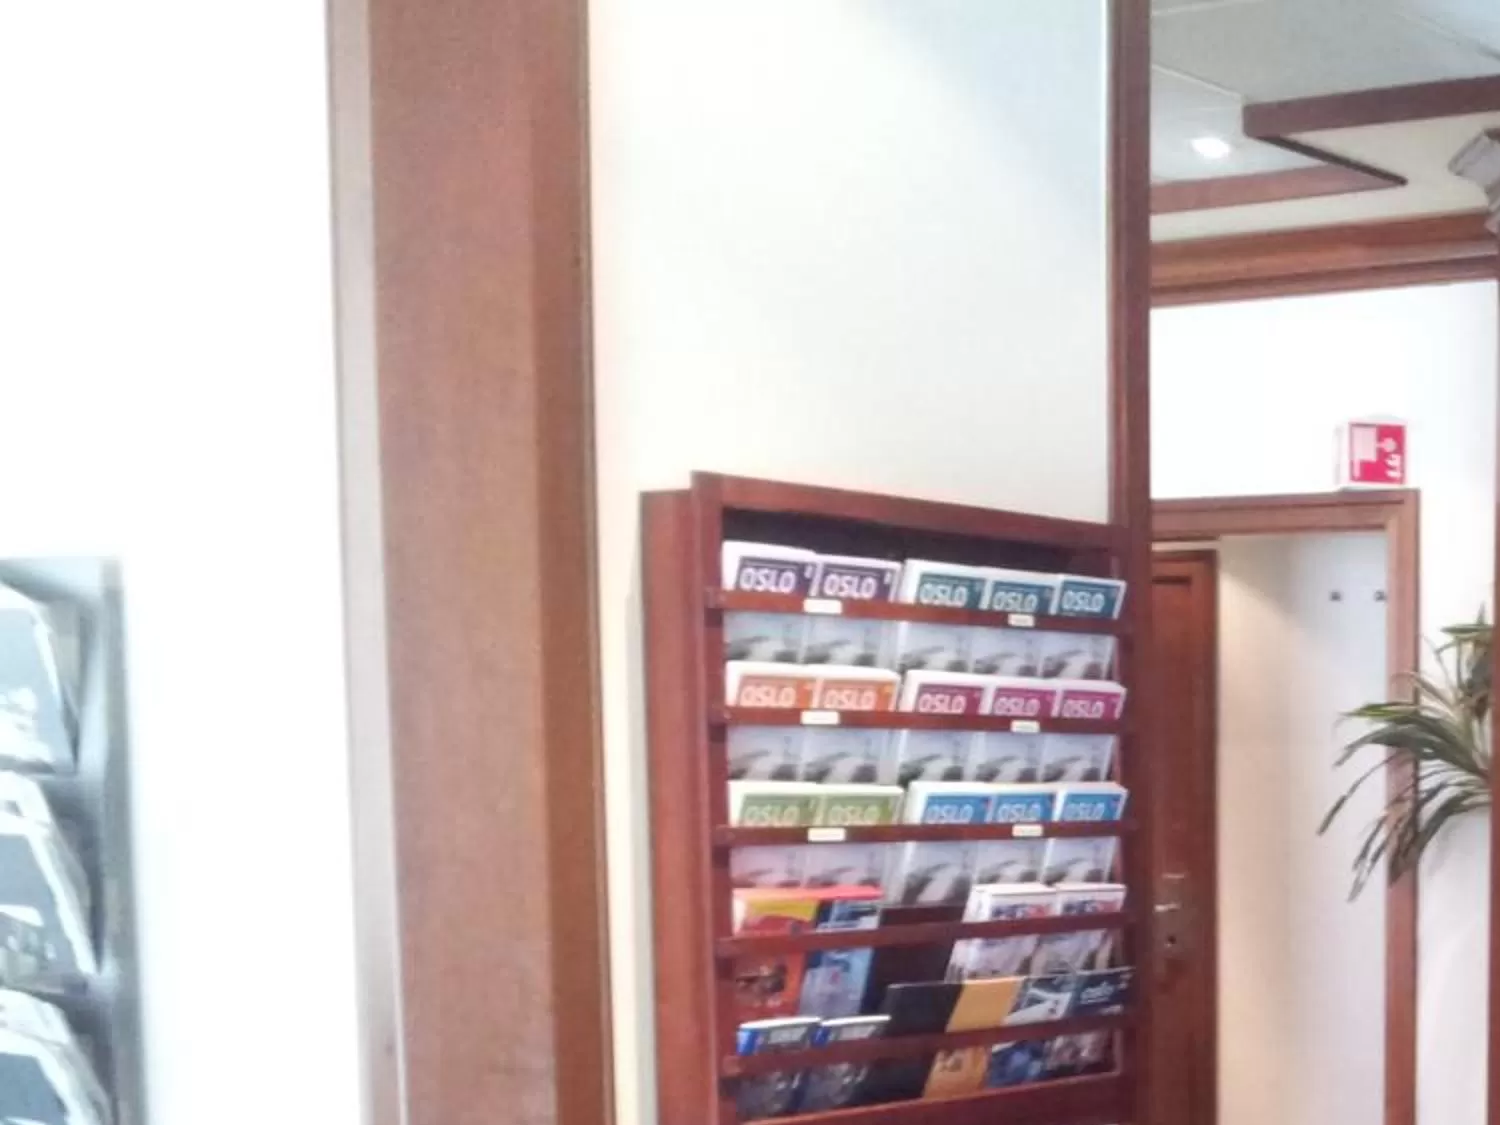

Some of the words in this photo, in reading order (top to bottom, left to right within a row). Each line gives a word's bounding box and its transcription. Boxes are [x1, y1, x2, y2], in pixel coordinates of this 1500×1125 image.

[739, 566, 797, 594] OSLO
[823, 573, 877, 600] OSLO
[918, 582, 969, 608] OSLO
[991, 590, 1039, 613] OSLO
[1061, 589, 1106, 613] OSLO
[739, 685, 797, 708] OSLO
[822, 689, 877, 711] OSLO
[917, 692, 968, 715] OSLO
[994, 696, 1041, 717] OSLO
[1061, 698, 1105, 719] OSLO
[923, 803, 974, 824] OSLO
[996, 803, 1042, 823] OSLO
